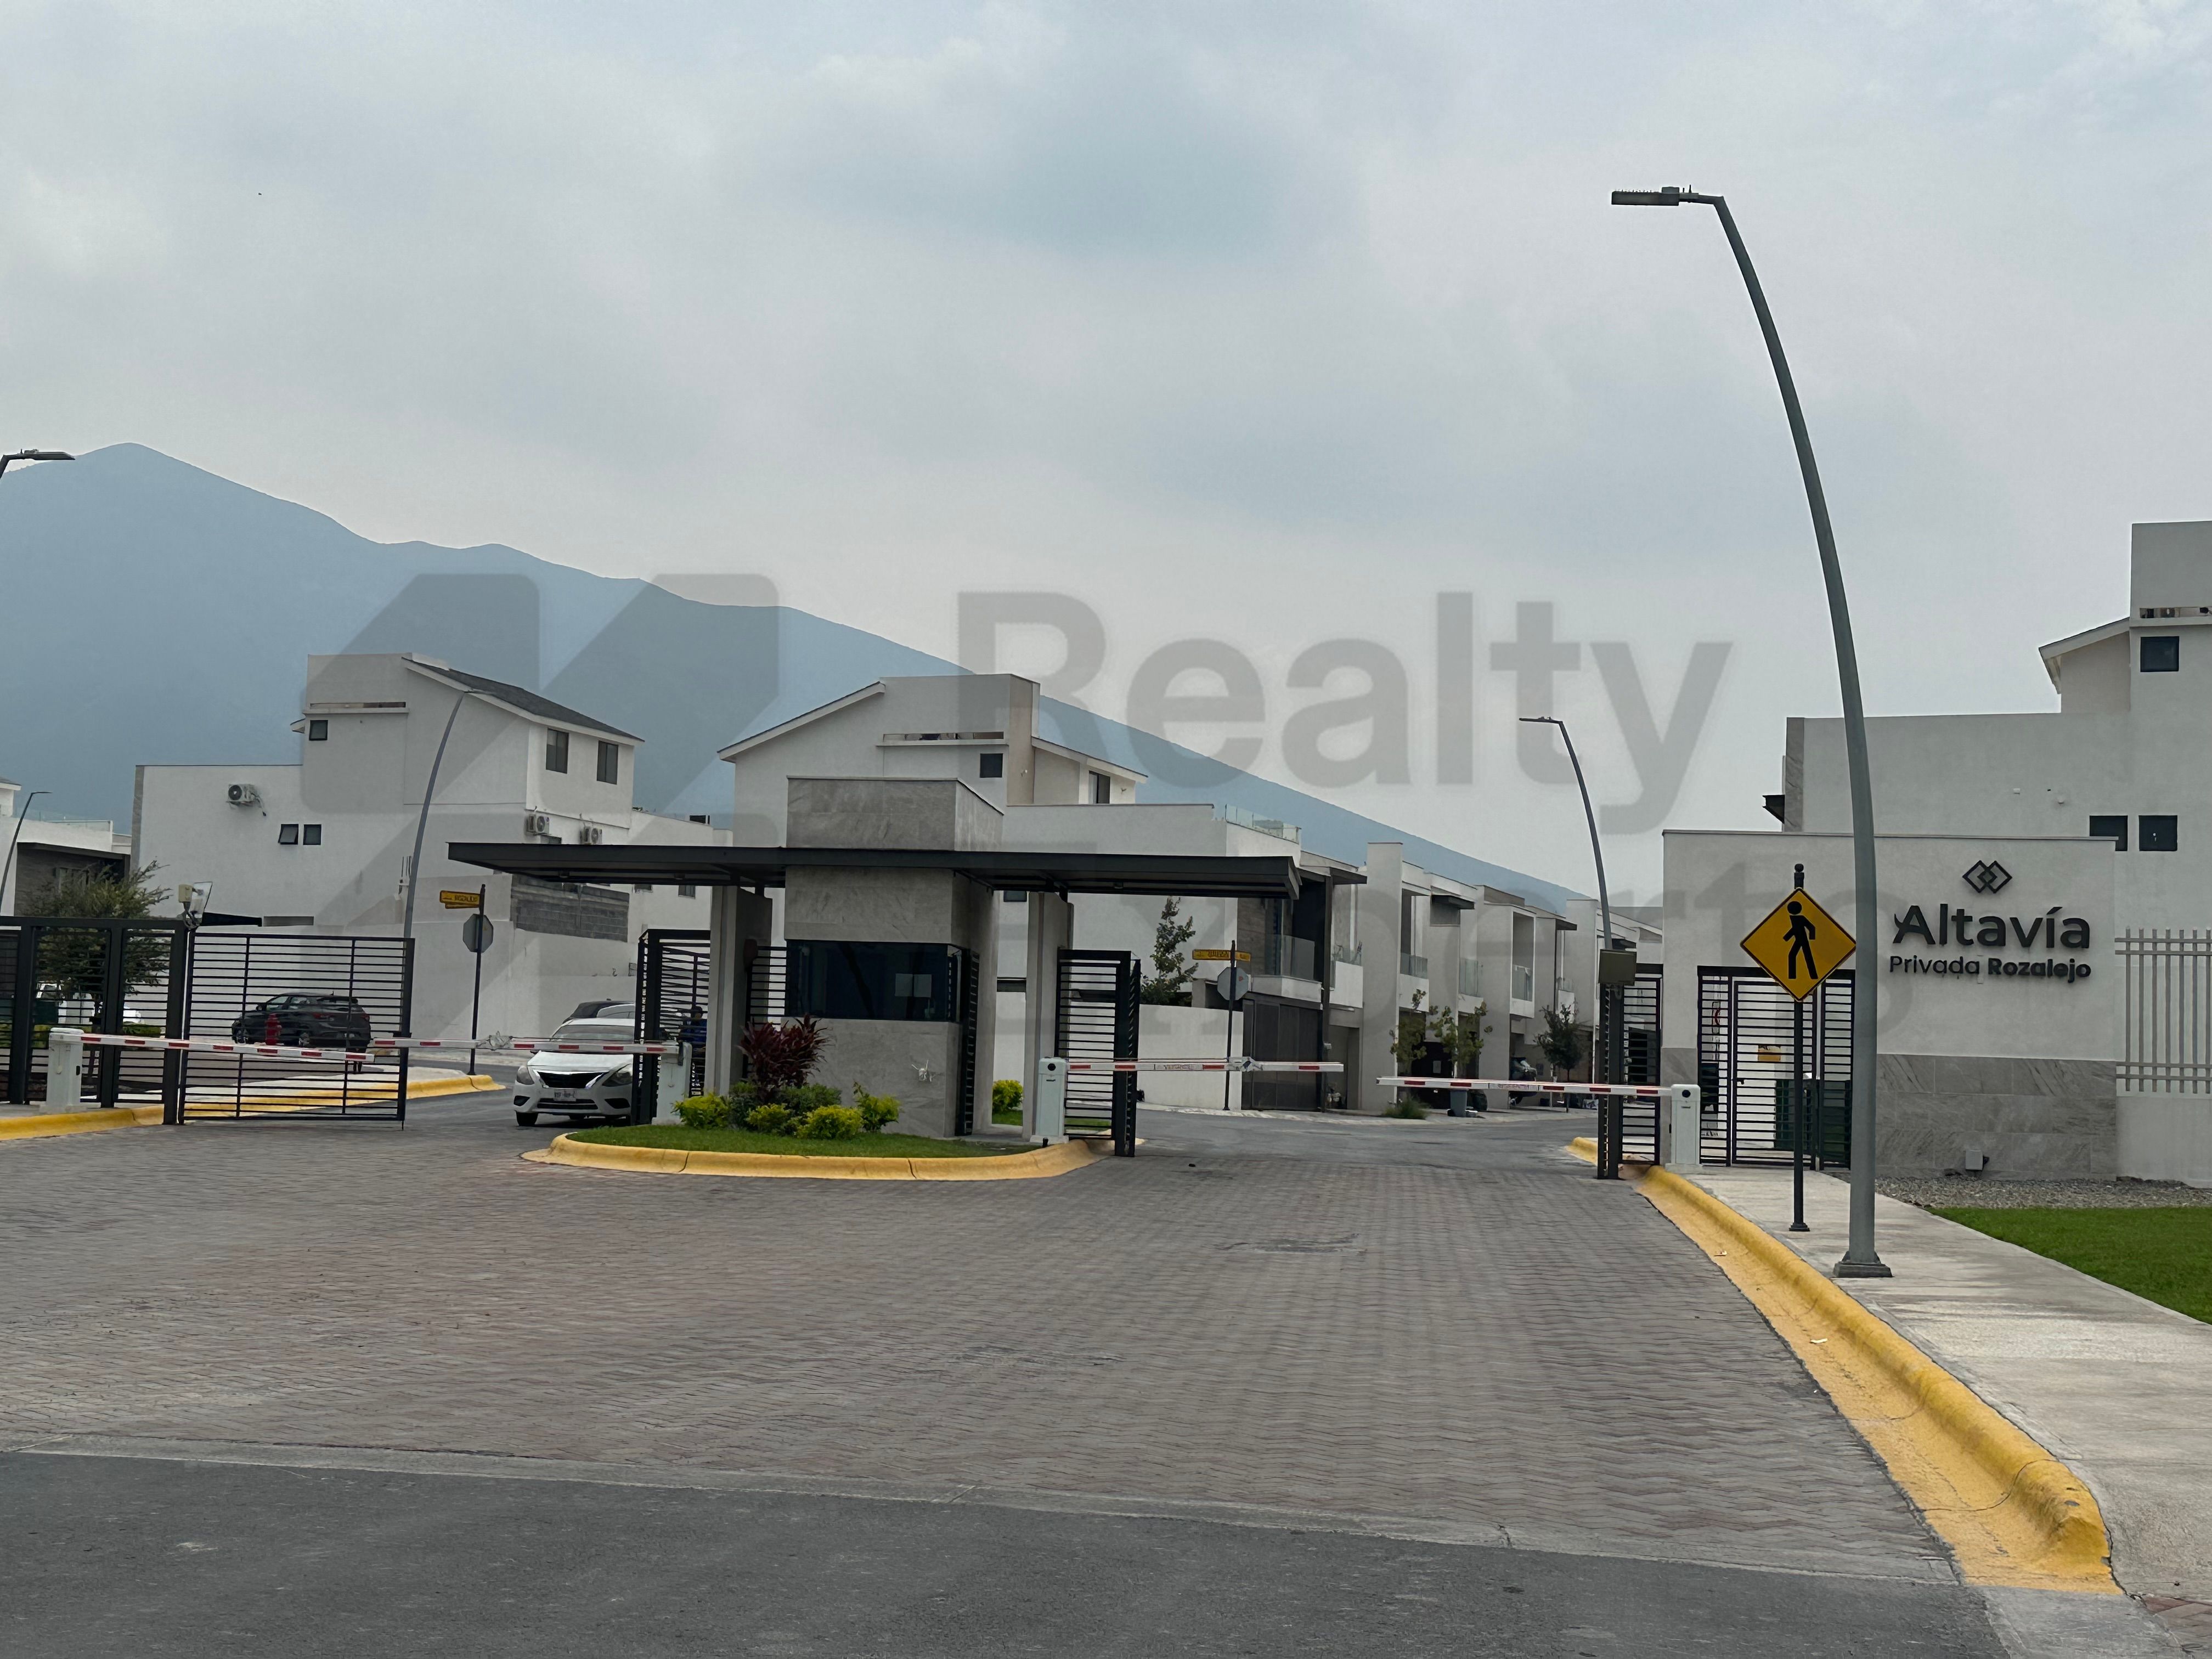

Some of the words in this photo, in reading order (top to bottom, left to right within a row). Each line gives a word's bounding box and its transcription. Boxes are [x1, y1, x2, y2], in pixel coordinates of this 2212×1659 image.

[1893, 903, 2090, 949] Altavía
[1889, 955, 1980, 975] Privada
[1988, 957, 2091, 983] Rozalejo
